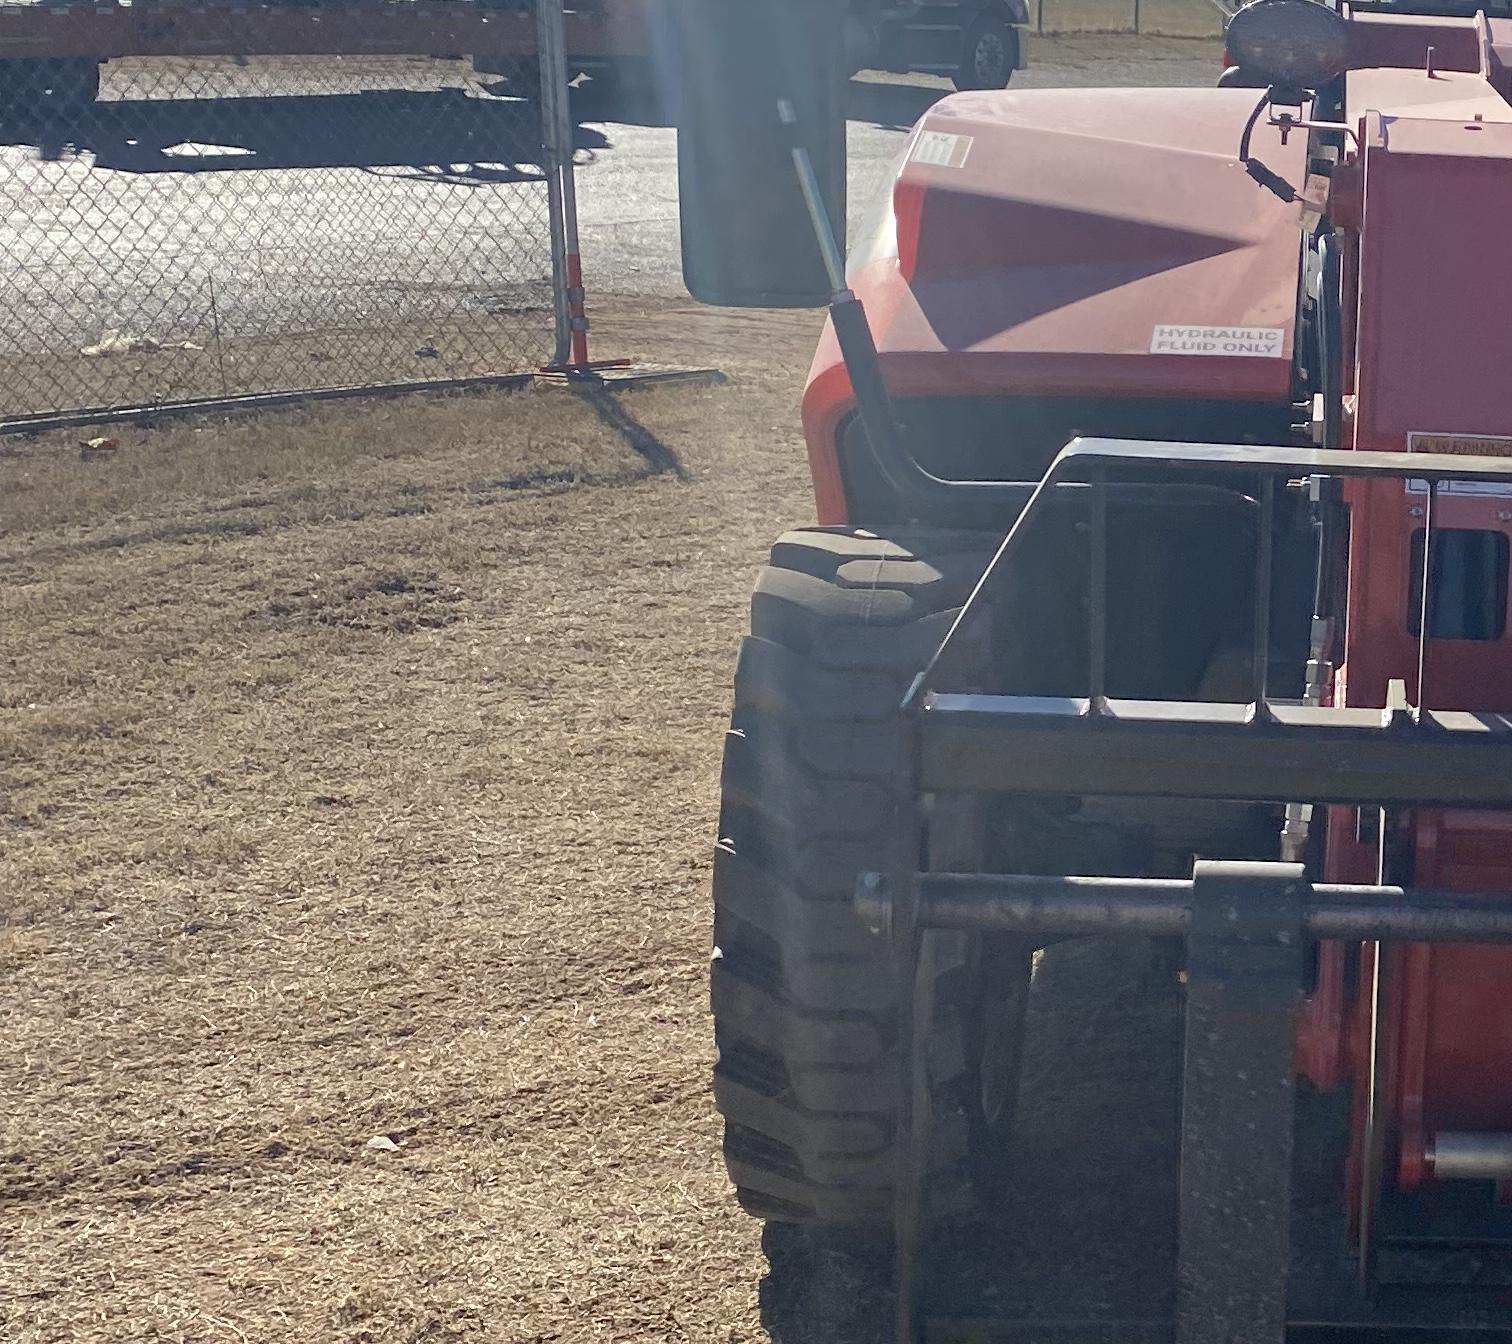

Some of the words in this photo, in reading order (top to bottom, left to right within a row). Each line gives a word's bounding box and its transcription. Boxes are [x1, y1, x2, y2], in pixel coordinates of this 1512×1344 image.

[1159, 328, 1279, 341] HYDRAULIC
[1157, 340, 1217, 351] FLUID
[1223, 342, 1276, 353] ONLY
